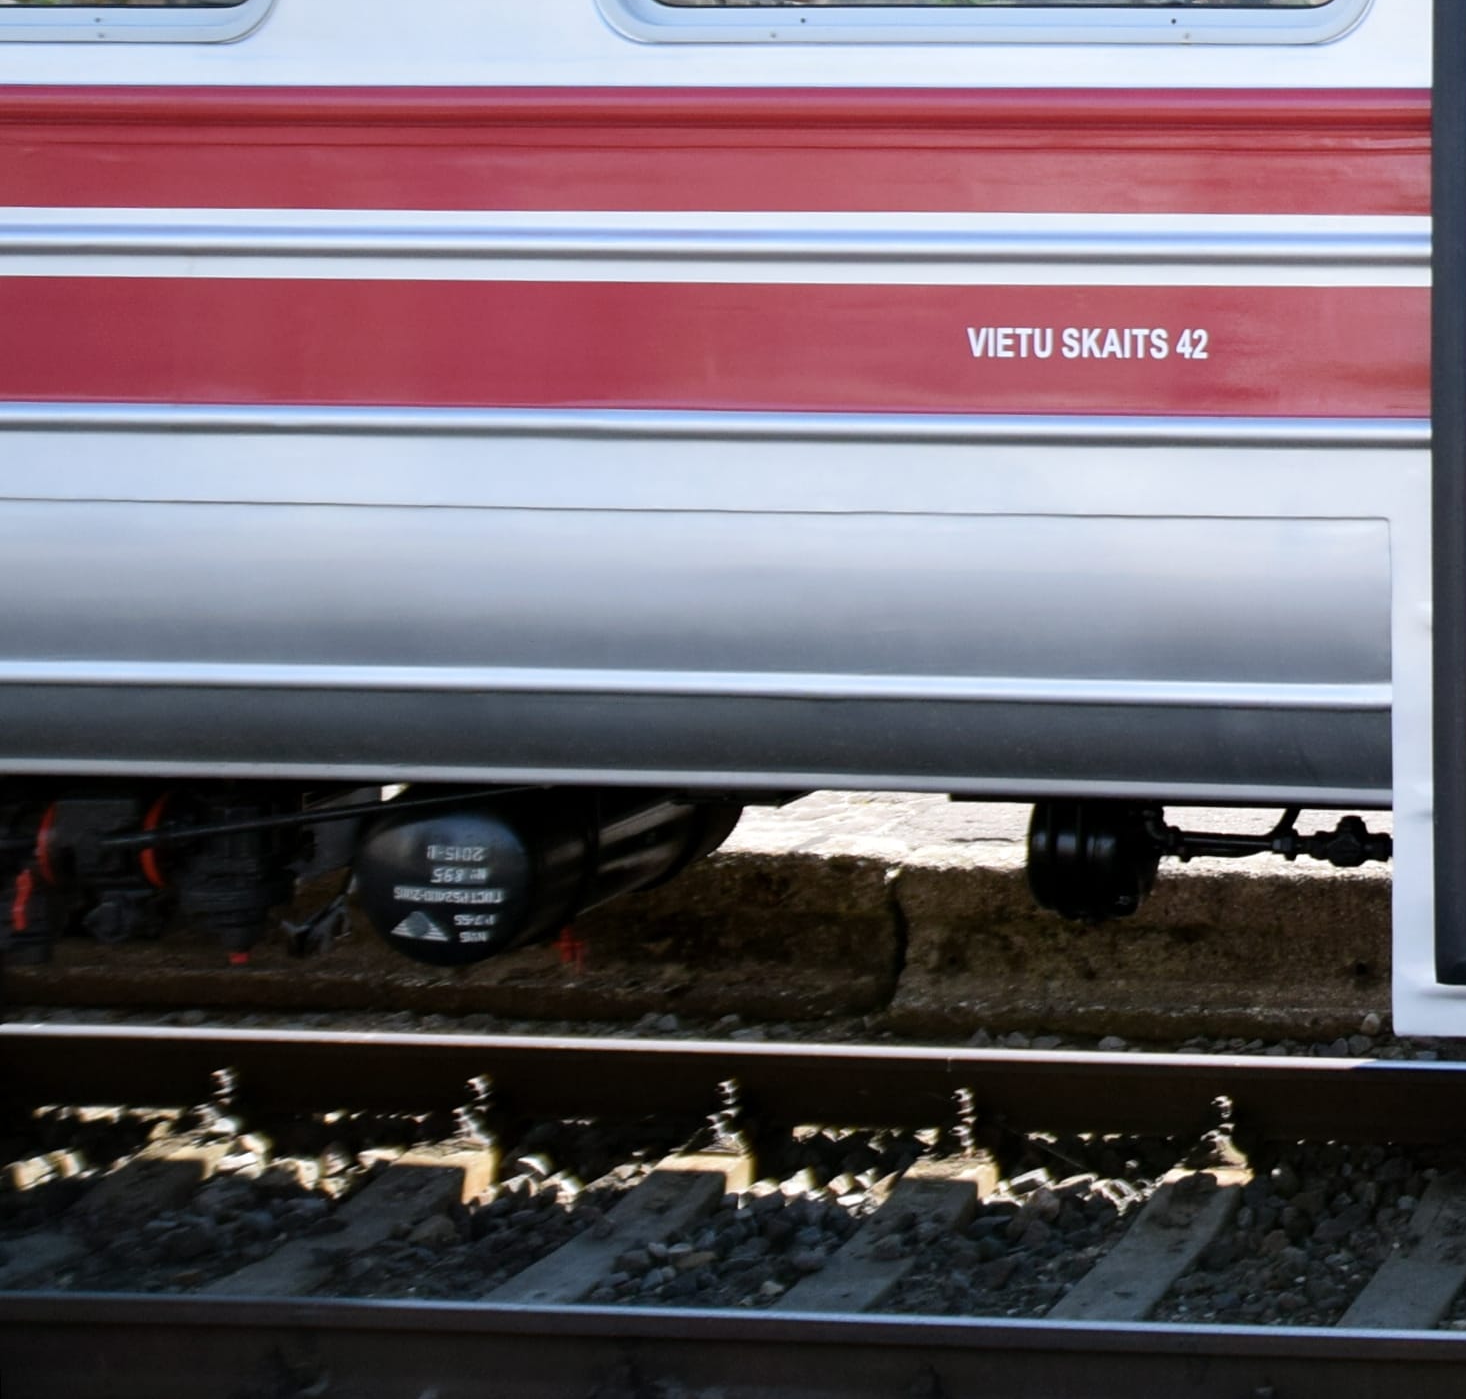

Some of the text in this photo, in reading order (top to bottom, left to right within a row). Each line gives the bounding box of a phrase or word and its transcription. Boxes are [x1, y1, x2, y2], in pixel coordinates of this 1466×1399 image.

[967, 327, 1209, 360] VIETU SKAITS 42
